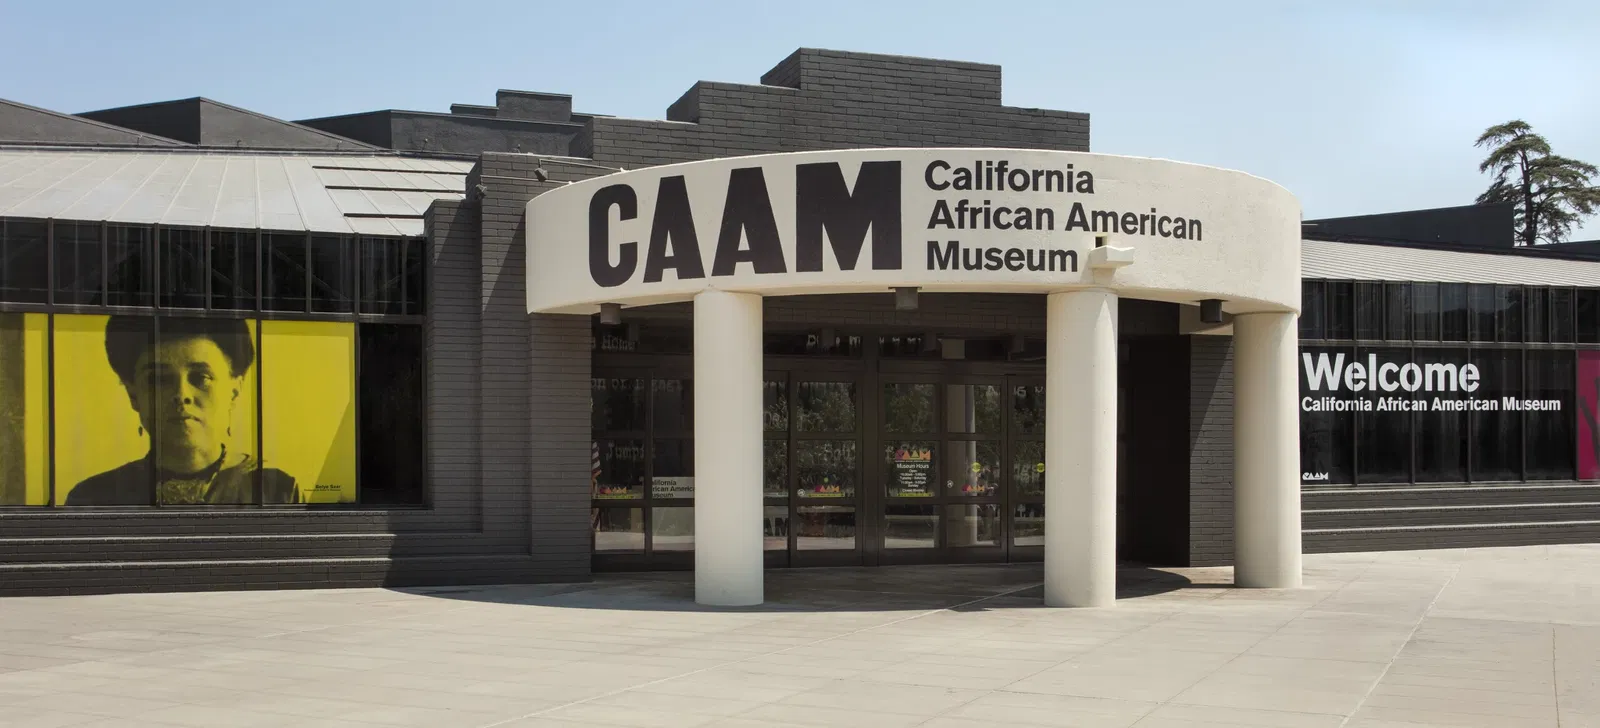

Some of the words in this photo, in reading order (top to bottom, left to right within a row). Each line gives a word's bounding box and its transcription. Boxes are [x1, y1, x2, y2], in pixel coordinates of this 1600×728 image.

[924, 159, 1095, 194] California
[588, 160, 903, 288] CAAM
[926, 199, 1055, 231] African
[1064, 201, 1203, 242] American
[926, 240, 1078, 273] Museum
[1302, 352, 1481, 392] Welcome
[1301, 396, 1373, 412] California
[1376, 396, 1428, 412] African
[1431, 396, 1499, 412] American
[1502, 396, 1562, 412] Museum
